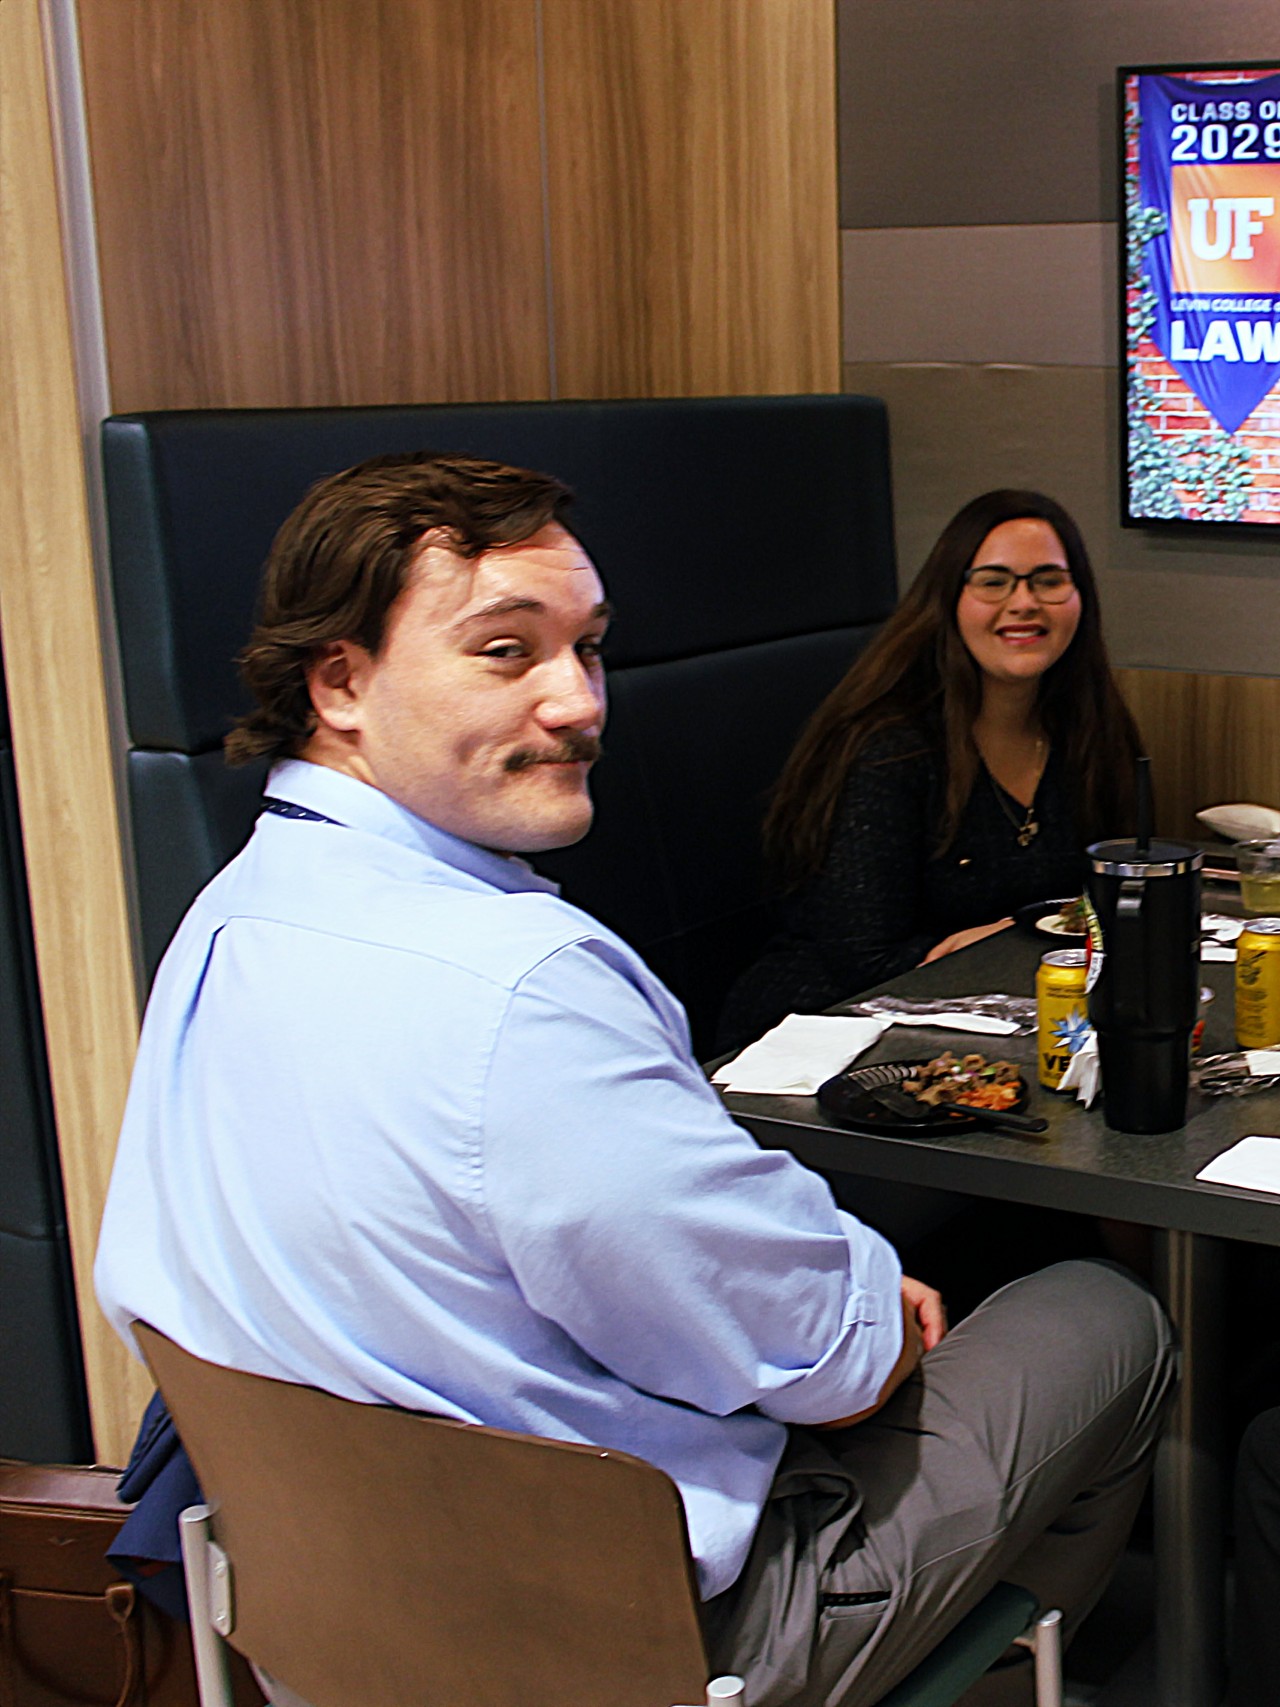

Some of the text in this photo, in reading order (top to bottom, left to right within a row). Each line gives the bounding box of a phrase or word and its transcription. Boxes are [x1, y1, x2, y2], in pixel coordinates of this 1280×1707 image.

[1171, 101, 1250, 122] CLASS
[1187, 197, 1275, 261] UF
[1212, 298, 1272, 312] COLLEGE
